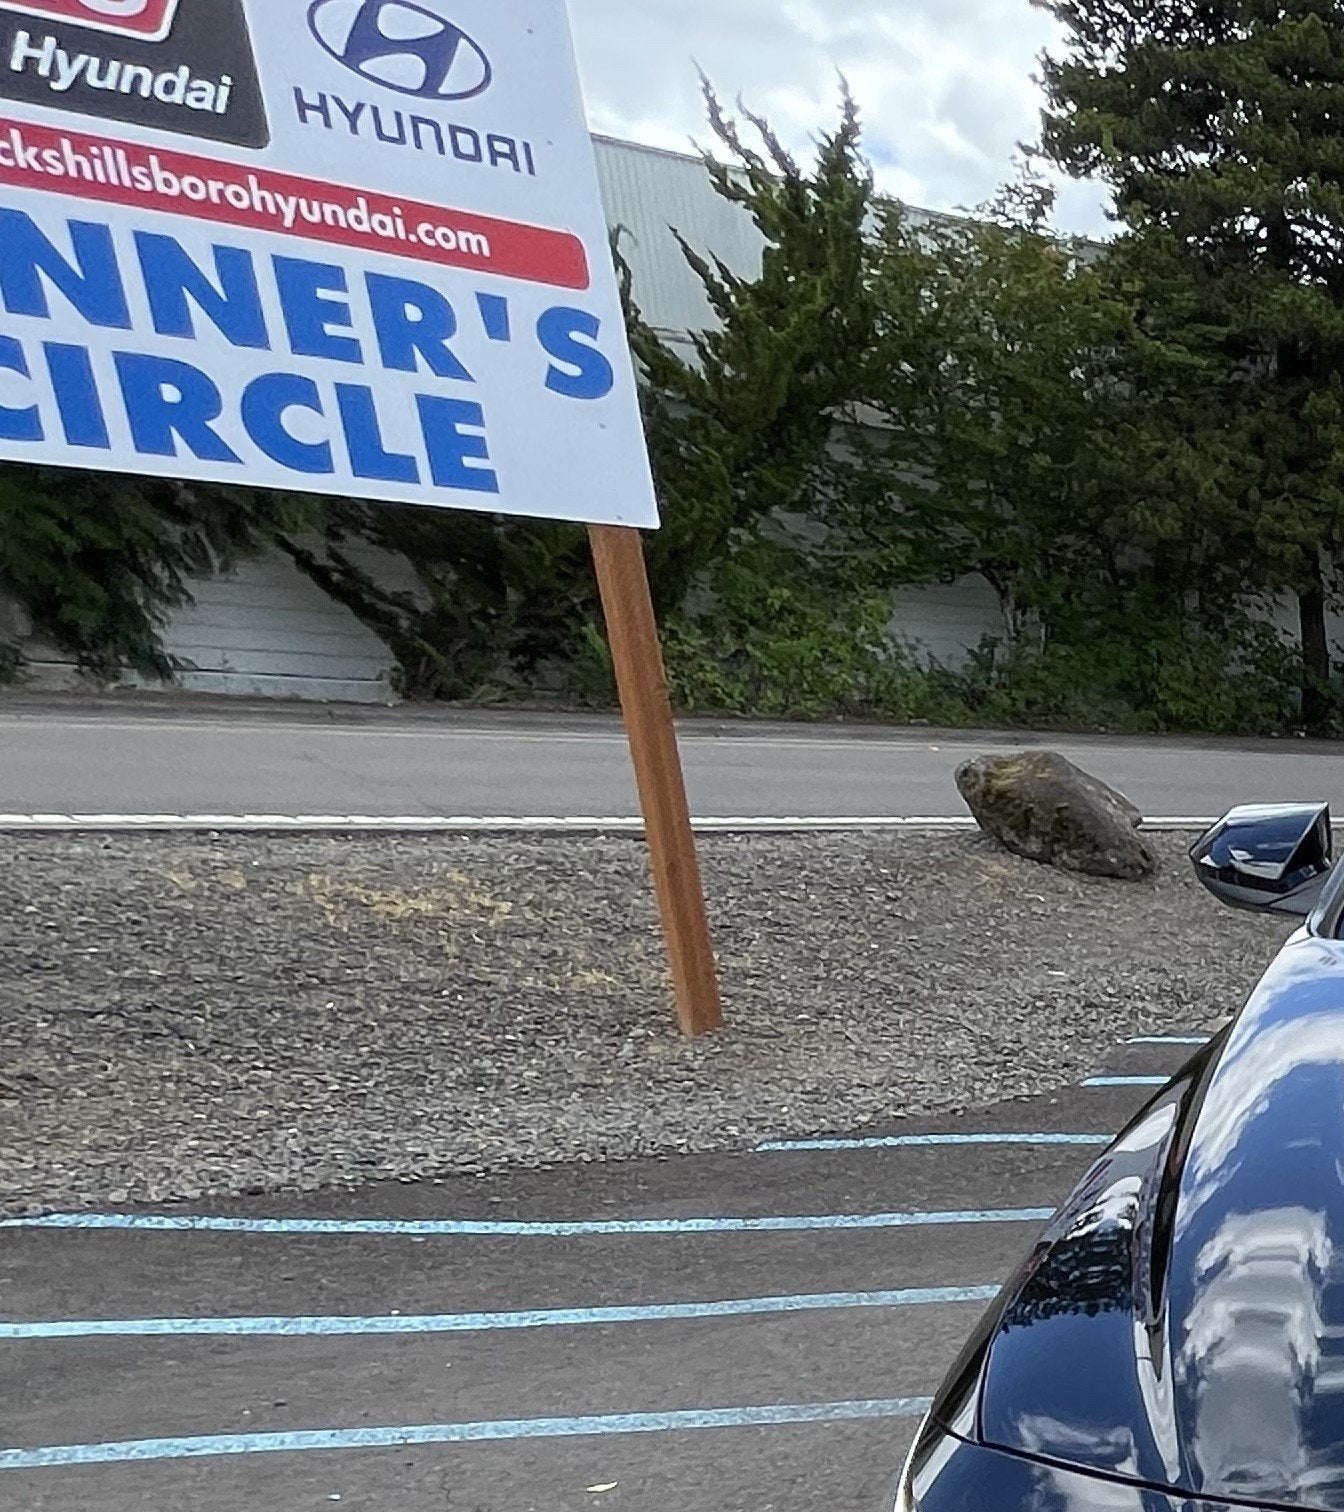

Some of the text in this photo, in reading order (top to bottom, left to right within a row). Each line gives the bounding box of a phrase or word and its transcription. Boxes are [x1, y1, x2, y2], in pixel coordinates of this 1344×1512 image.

[10, 30, 234, 114] Hyundai
[293, 86, 537, 176] HYUNDAI
[0, 128, 490, 257] ckshillsborohyundai.com
[0, 207, 615, 400] NNER'S
